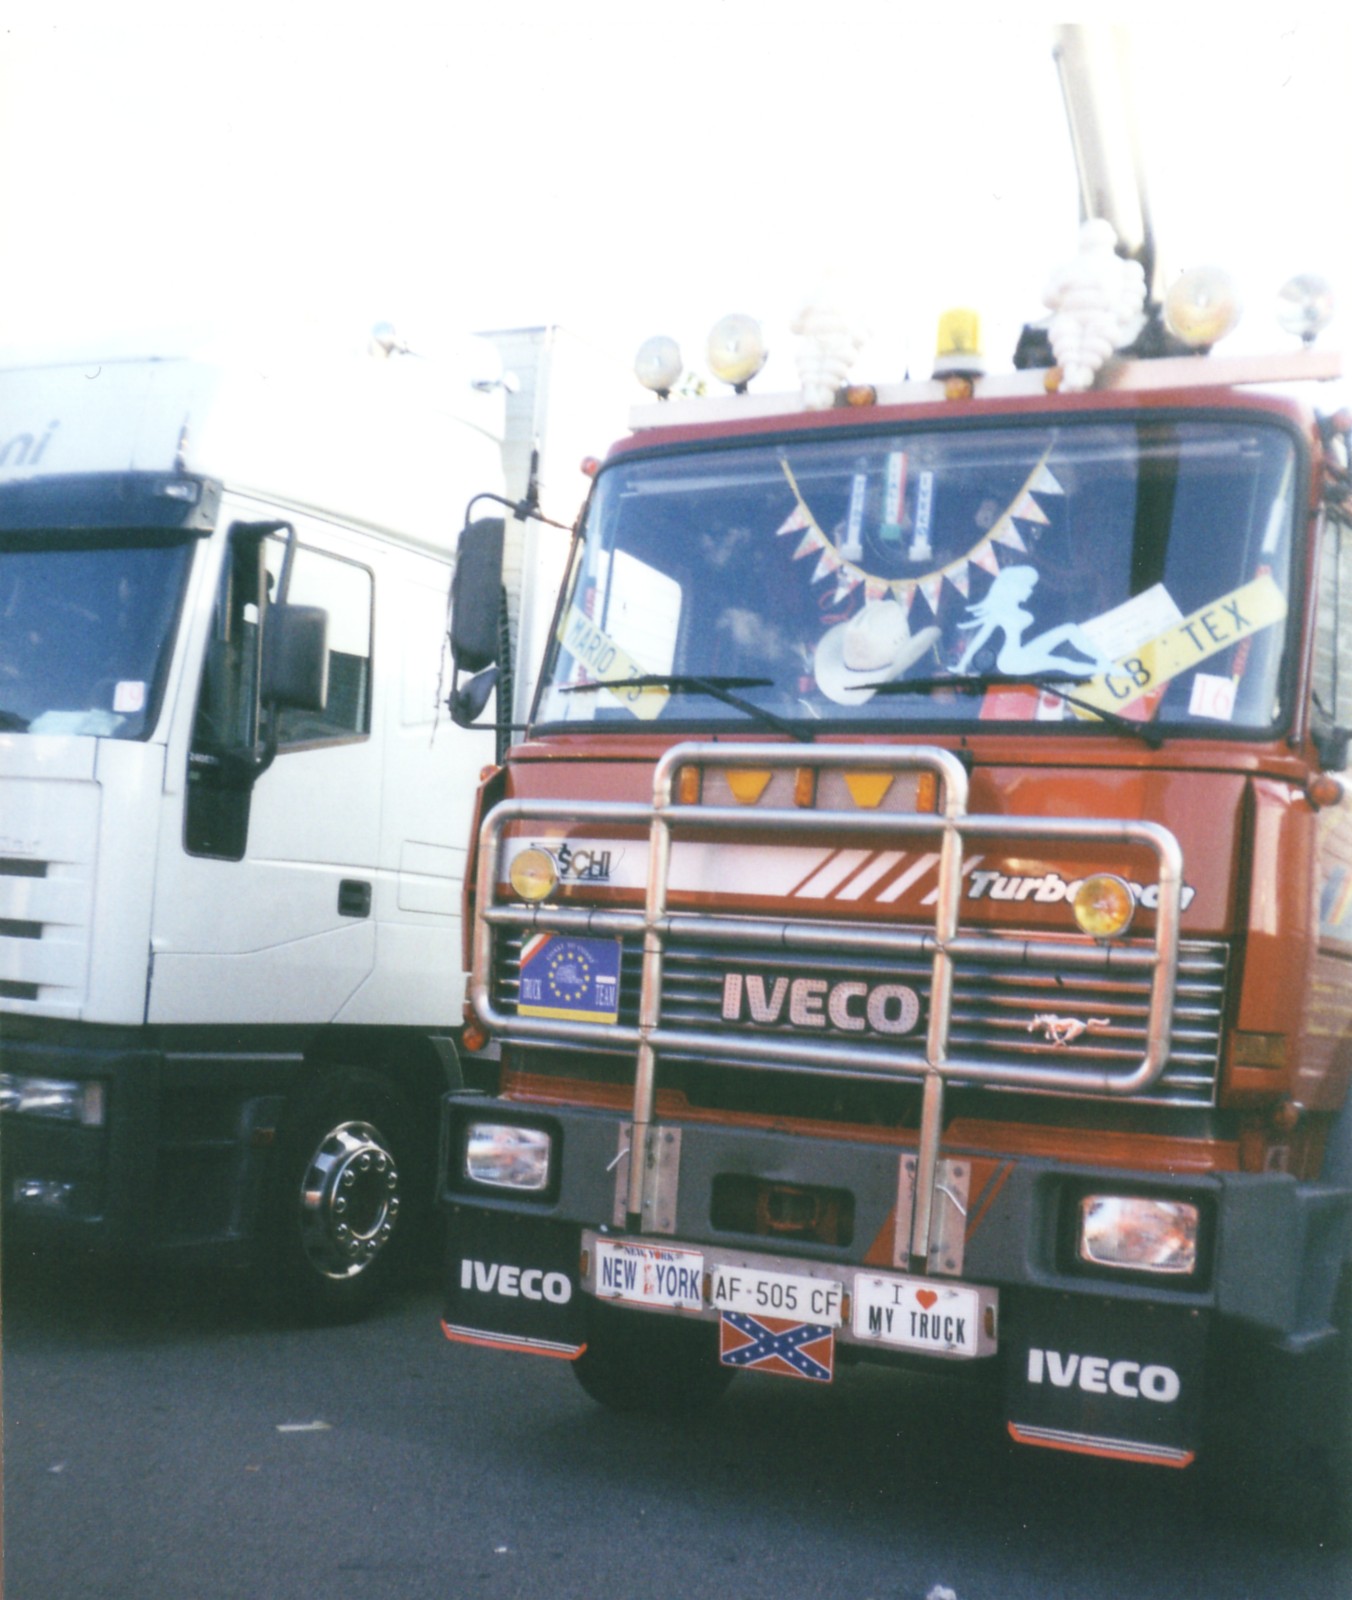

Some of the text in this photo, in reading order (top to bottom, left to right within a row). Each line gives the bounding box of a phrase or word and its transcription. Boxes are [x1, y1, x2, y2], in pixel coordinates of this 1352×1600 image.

[566, 619, 617, 674] MARIO
[1104, 600, 1252, 699] CB TEX
[722, 973, 920, 1034] IVECO
[460, 1258, 572, 1305] IVECO
[602, 1251, 700, 1300] NEW YORK
[891, 1284, 903, 1306] I
[810, 1289, 838, 1316] CF
[868, 1305, 966, 1344] MY TRUCK
[1027, 1348, 1181, 1403] IVECO
